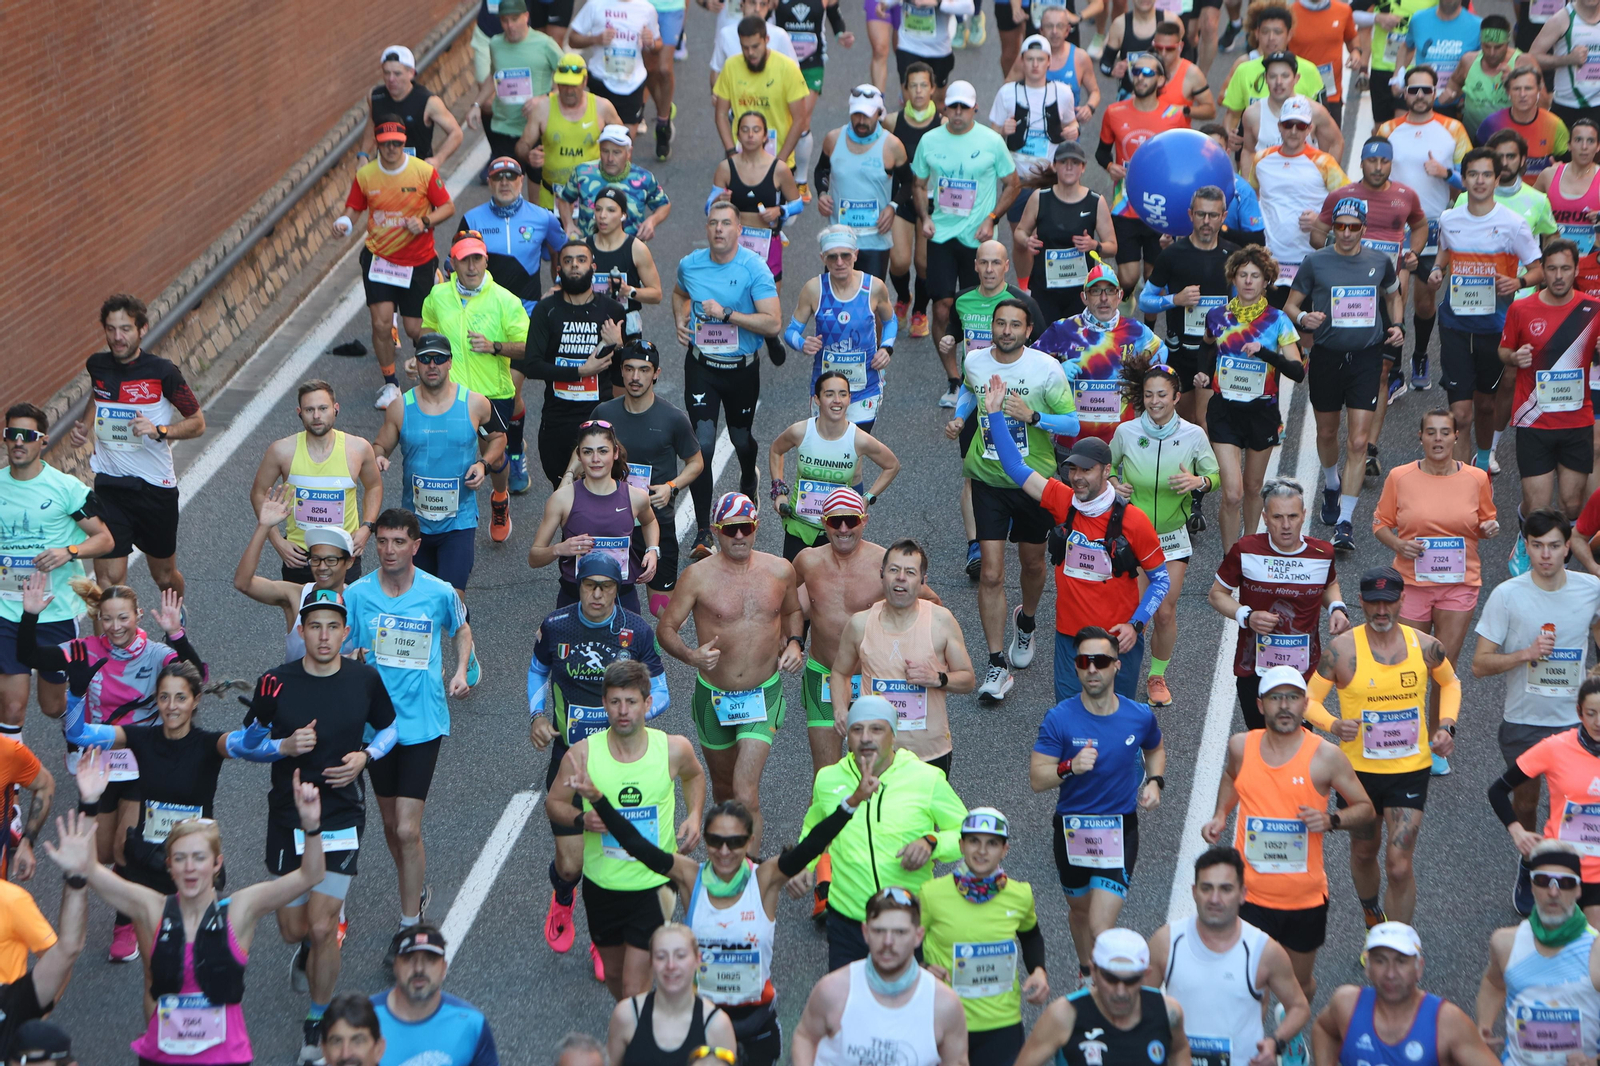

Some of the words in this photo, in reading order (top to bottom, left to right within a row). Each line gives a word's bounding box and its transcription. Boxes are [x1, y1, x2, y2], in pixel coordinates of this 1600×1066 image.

[605, 9, 628, 20] Run
[1436, 40, 1462, 49] LOOP
[738, 97, 770, 108] SEVILLA
[1028, 130, 1046, 138] URICH
[560, 147, 583, 157] LIAM
[950, 180, 972, 189] ZURICH
[850, 201, 874, 210] ZURICH
[1143, 192, 1168, 229] 3:45
[744, 228, 766, 236] ZURICH
[1566, 226, 1590, 234] ZURICH
[1374, 243, 1397, 251] ZURICH
[1060, 250, 1080, 258] ZURICH
[1452, 264, 1497, 274] MARCHENA
[562, 322, 598, 333] ZAWAR
[562, 334, 598, 344] MUSLIM
[558, 346, 596, 355] RUNNER
[1236, 361, 1261, 370] ZURICH
[1234, 375, 1248, 384] 9098
[1553, 372, 1578, 380] ZURICH
[803, 466, 844, 480] sano
[1079, 552, 1095, 562] 7519
[1264, 558, 1304, 568] FERRARA
[1250, 584, 1274, 594] Culture,
[398, 621, 427, 630] ZURICH
[394, 638, 416, 647] 10162
[1274, 638, 1302, 646] ZURICH
[570, 641, 616, 658] ATLETICA
[1548, 651, 1577, 659] ZURICH
[1368, 692, 1418, 703] RUNNINGZEN
[1382, 711, 1412, 720] ZURICH
[1383, 738, 1408, 747] BARONE
[1084, 820, 1114, 828] ZURICH
[1266, 822, 1300, 831] ZURICH
[1264, 841, 1288, 849] 10527
[1100, 878, 1124, 895] TEAM
[976, 944, 1010, 955] ZURICH
[718, 954, 752, 963] ZURICH
[716, 972, 741, 980] 10825
[716, 984, 740, 992] NIEVES
[1535, 1009, 1572, 1022] ZURICH
[870, 1038, 896, 1050] THE
[848, 1046, 896, 1062] NORTH
